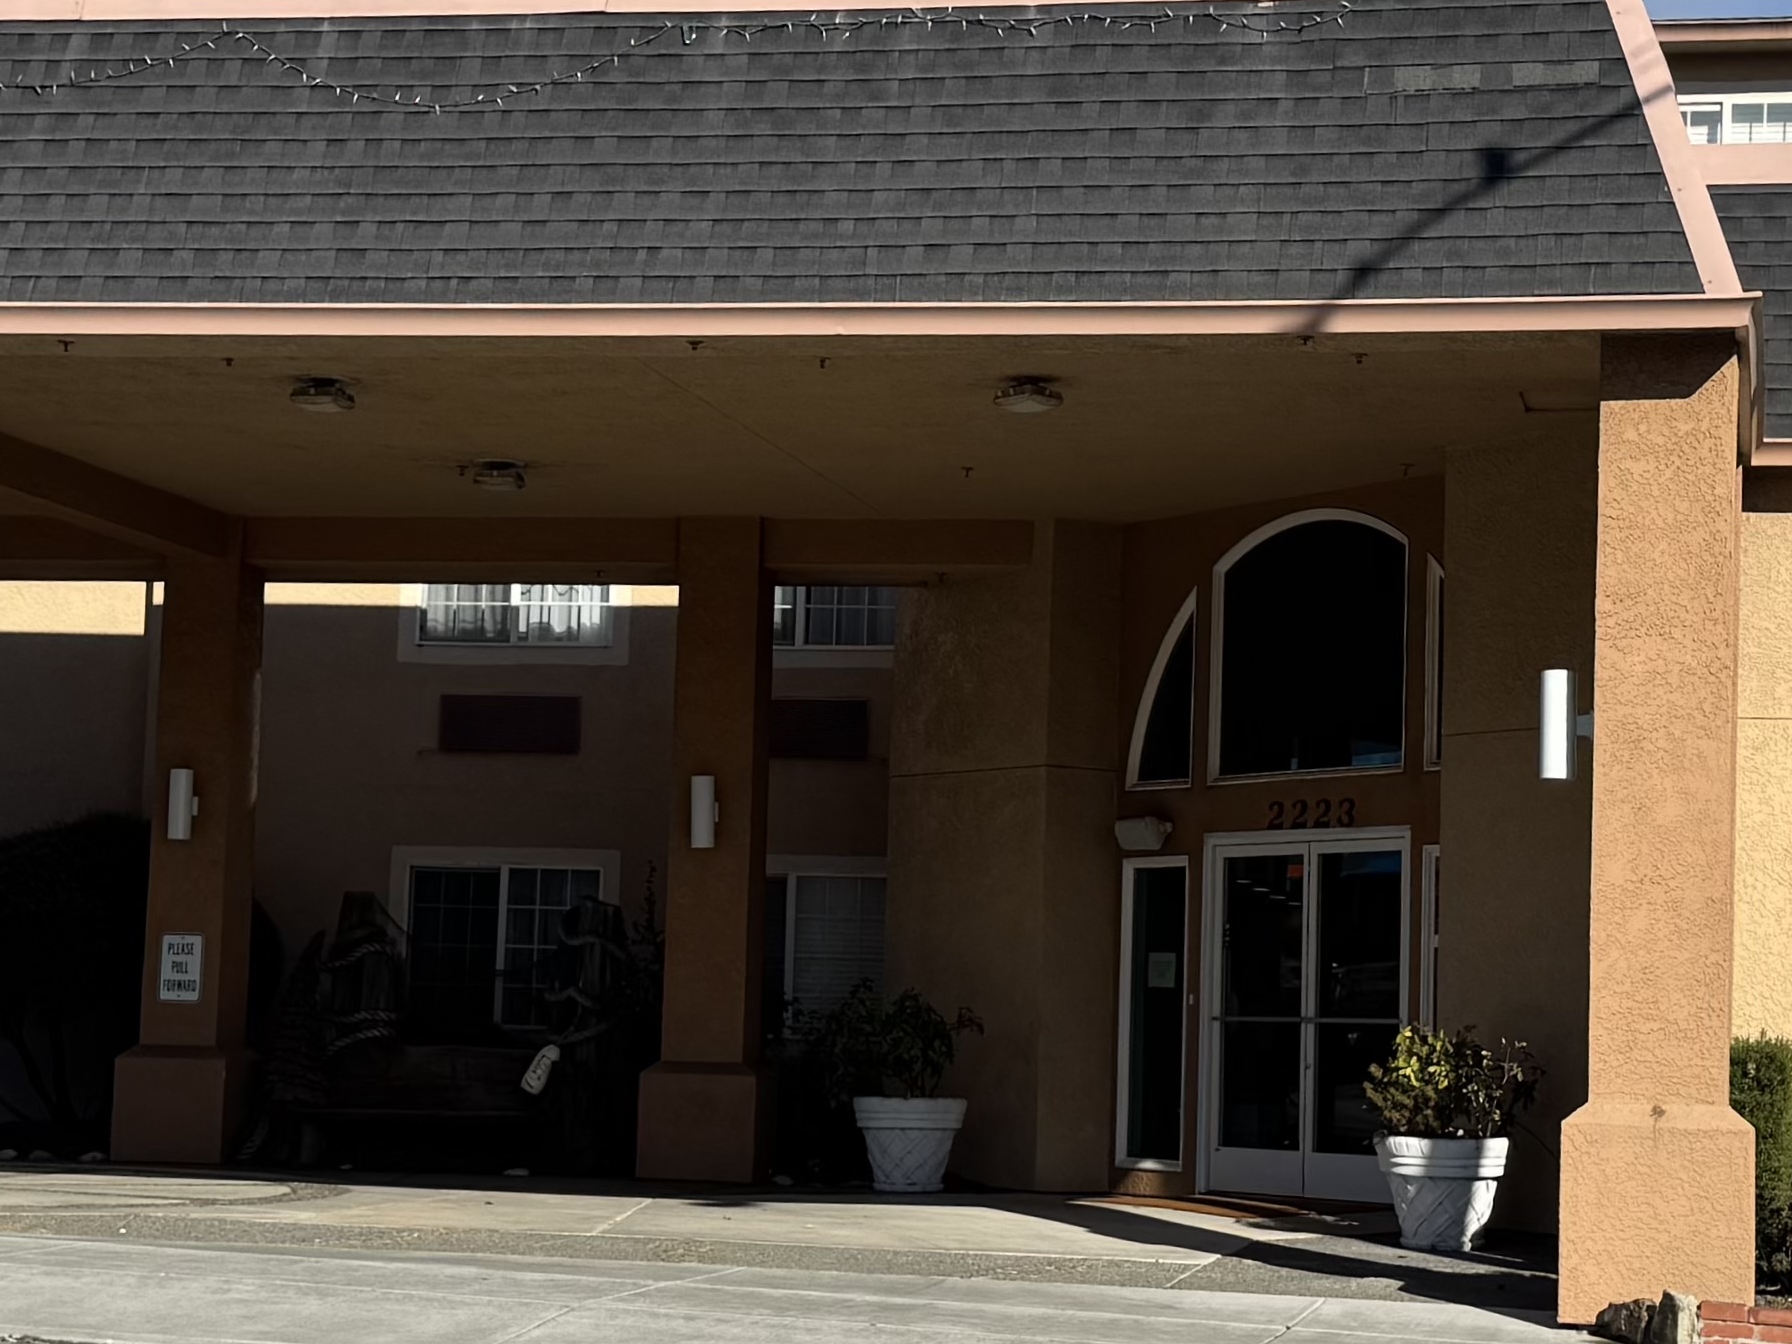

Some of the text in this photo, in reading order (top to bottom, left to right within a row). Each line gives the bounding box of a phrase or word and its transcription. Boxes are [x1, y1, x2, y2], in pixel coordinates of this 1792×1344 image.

[1266, 797, 1357, 830] 2223
[167, 942, 194, 956] PLEASE
[171, 960, 188, 974] PULL
[162, 978, 197, 993] FORWARD
